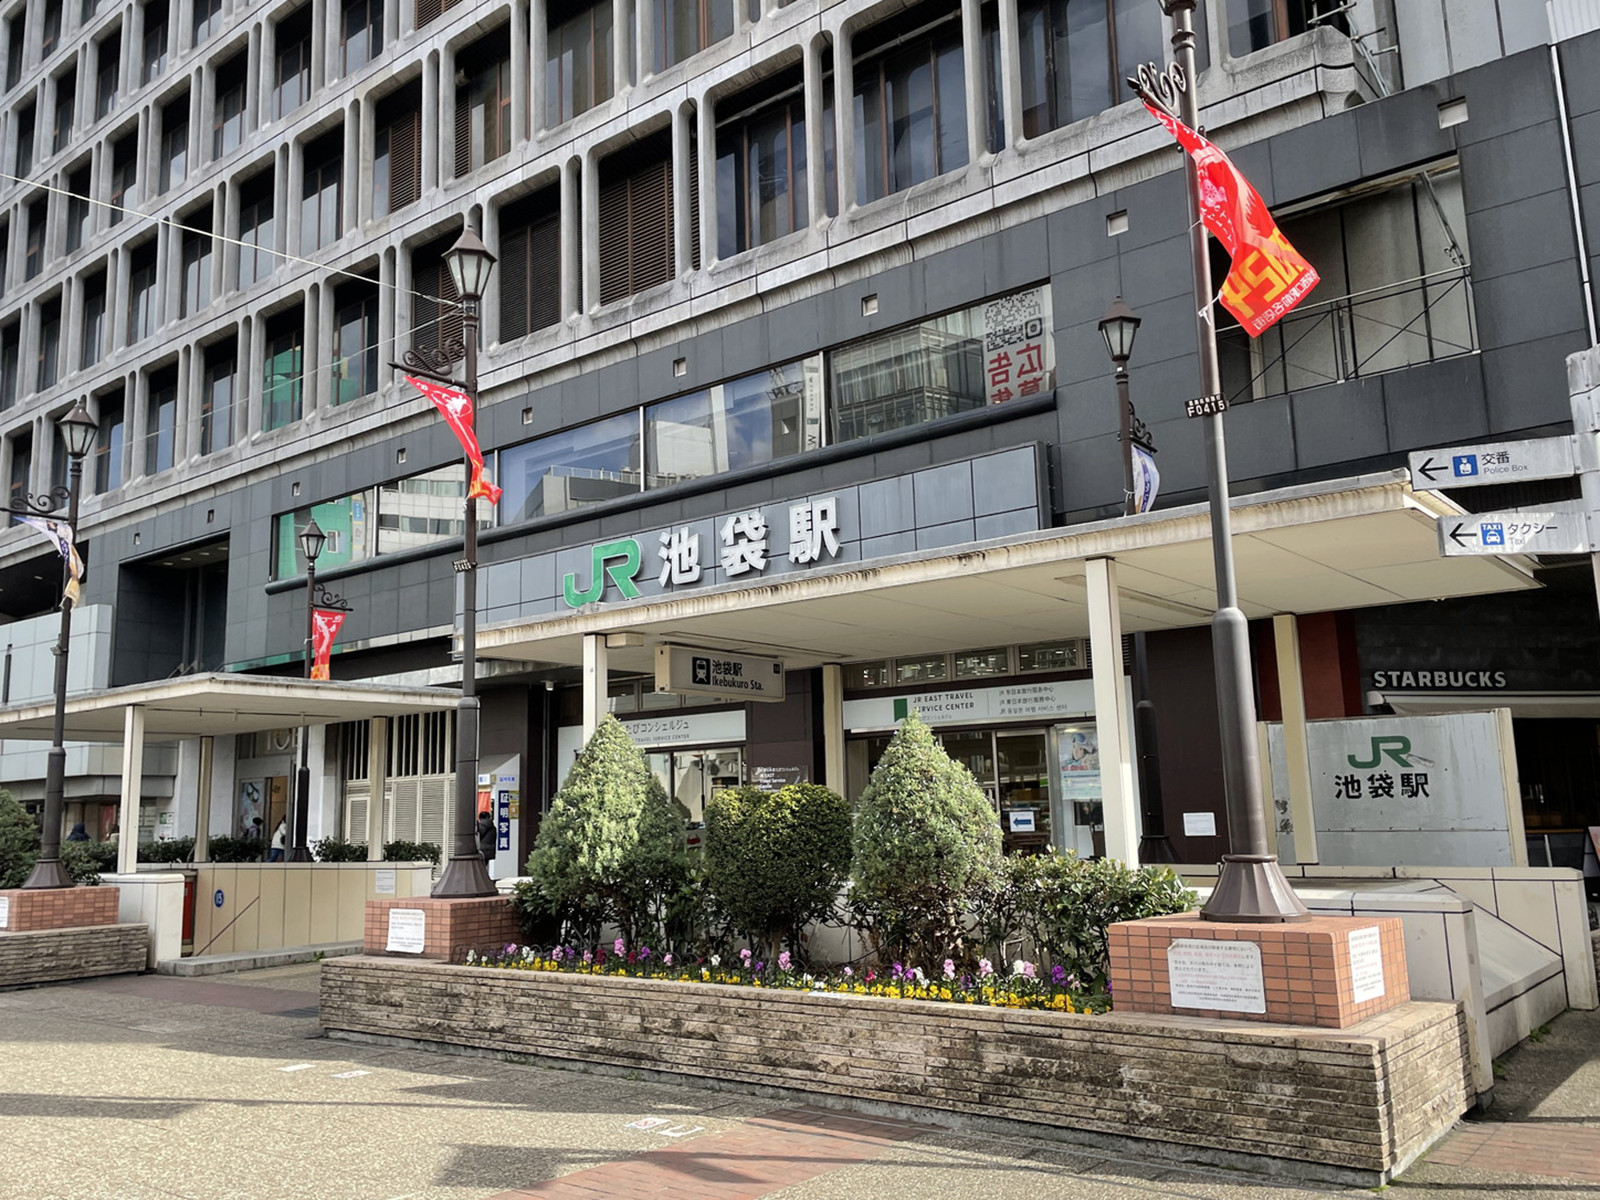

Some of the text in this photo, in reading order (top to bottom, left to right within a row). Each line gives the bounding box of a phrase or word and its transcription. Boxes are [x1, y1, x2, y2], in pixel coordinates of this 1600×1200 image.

[1187, 400, 1226, 417] F0415
[1481, 450, 1510, 466] 交番
[1483, 463, 1529, 475] Police Box
[1482, 523, 1502, 531] TAXI
[1507, 522, 1558, 536] タクシー
[1508, 536, 1526, 546] Taxi
[563, 496, 842, 608] JR 池袋駅
[712, 660, 743, 679] 池袋駅
[712, 675, 749, 690] Ikebukuro
[1373, 670, 1508, 689] STARBUCKS
[925, 694, 943, 703] EAST
[945, 692, 974, 700] TRAVEL
[945, 701, 975, 711] CENTER
[1348, 735, 1413, 769] JR
[1334, 772, 1431, 801] 池袋駅
[499, 792, 509, 849] 証明写真
